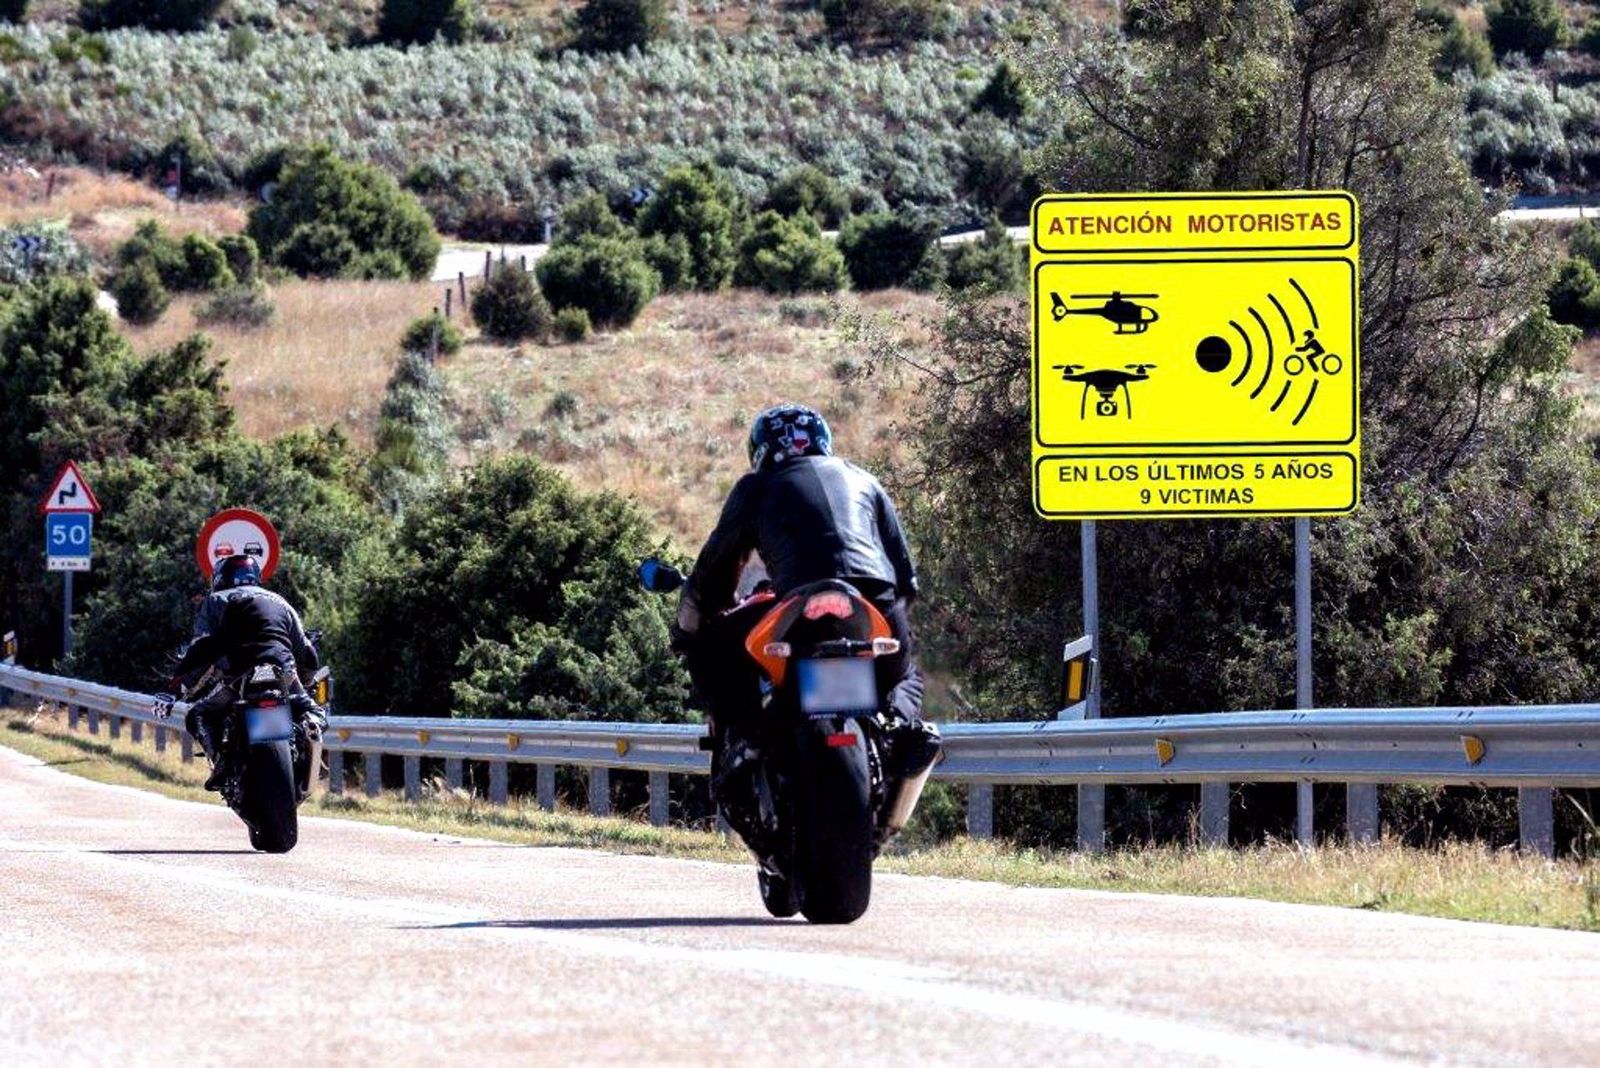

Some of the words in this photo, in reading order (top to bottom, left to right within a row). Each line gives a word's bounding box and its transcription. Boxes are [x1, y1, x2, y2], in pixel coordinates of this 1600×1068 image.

[1048, 211, 1172, 235] ATENCIÓN
[1188, 212, 1341, 234] MOTORISTAS
[1058, 465, 1088, 482] EN
[1096, 464, 1139, 482] LOS
[1148, 460, 1245, 481] ÚLTIMOS
[1254, 463, 1265, 480] 5
[1272, 459, 1334, 480] AÑOS
[1140, 489, 1152, 505] 9
[1159, 487, 1254, 505] VICTIMAS
[53, 525, 86, 544] 50
